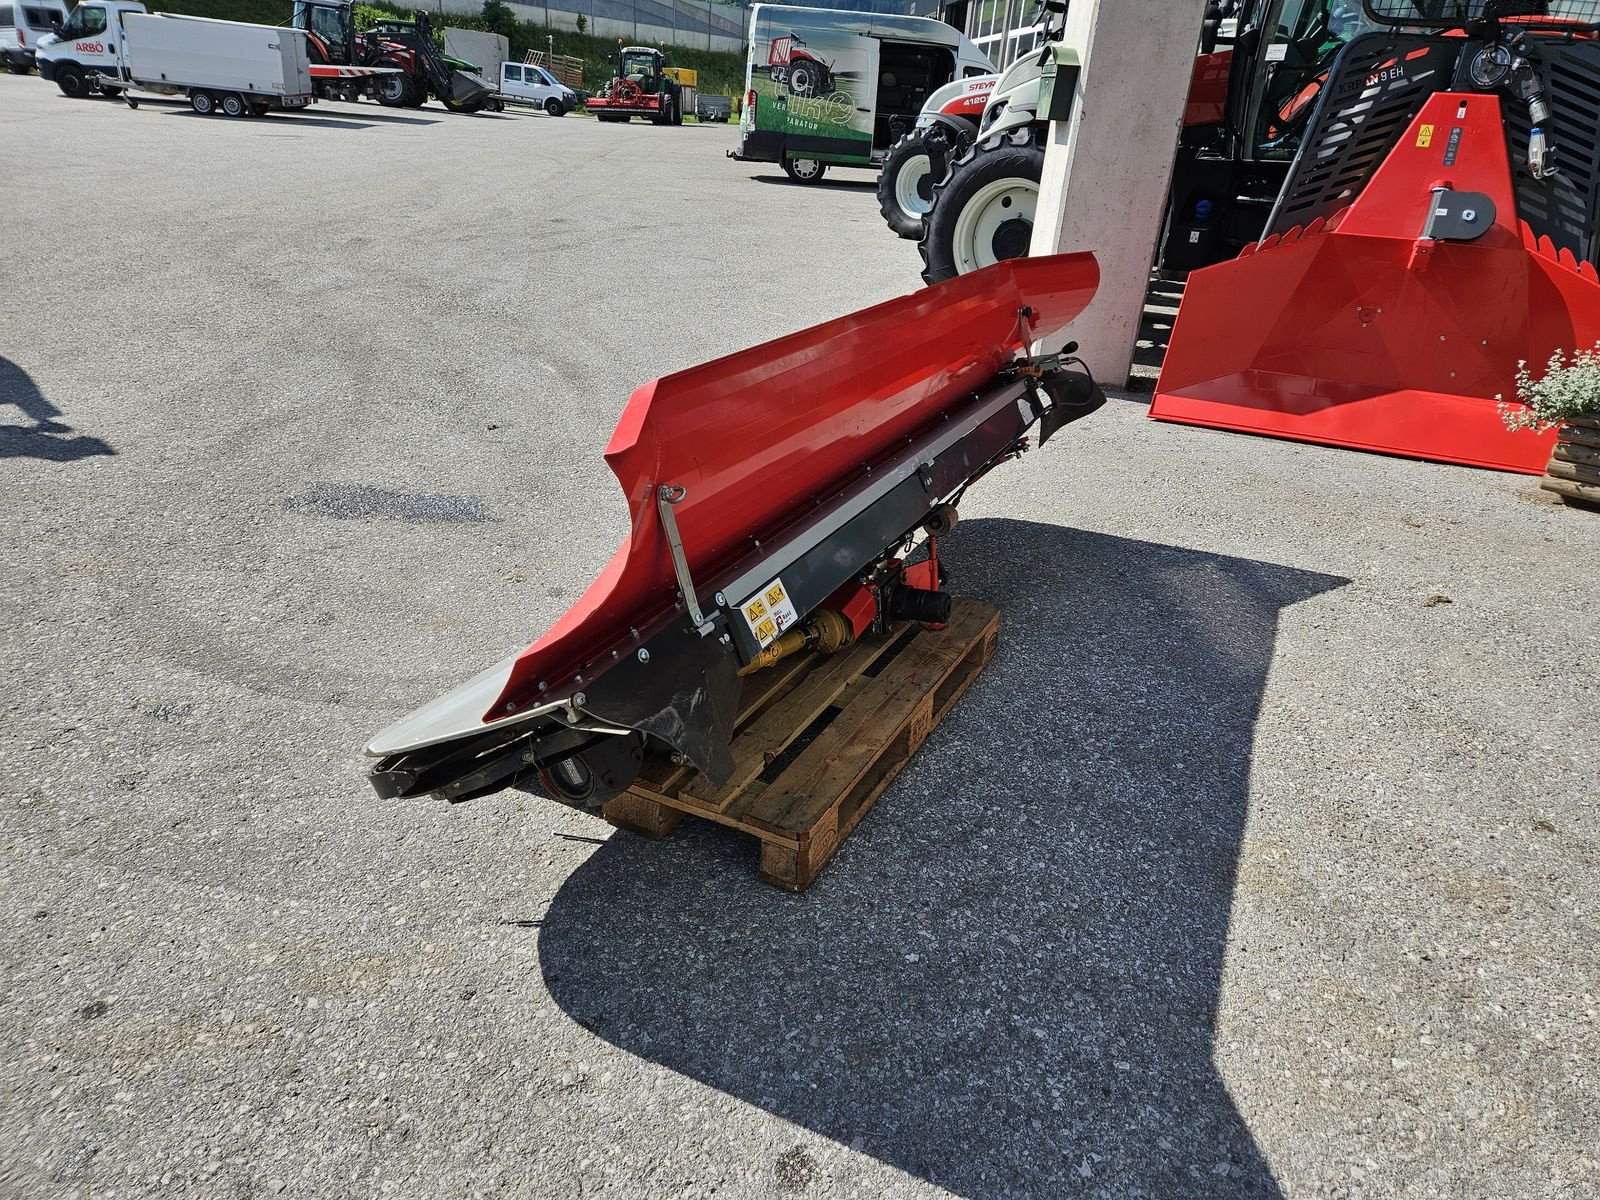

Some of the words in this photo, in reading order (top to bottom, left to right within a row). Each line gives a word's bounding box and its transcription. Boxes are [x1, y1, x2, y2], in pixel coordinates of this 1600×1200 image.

[76, 41, 104, 53] ARBÖ
[1380, 71, 1388, 82] 9
[1389, 66, 1404, 79] EH
[969, 81, 996, 91] STEYR
[772, 101, 787, 111] VER
